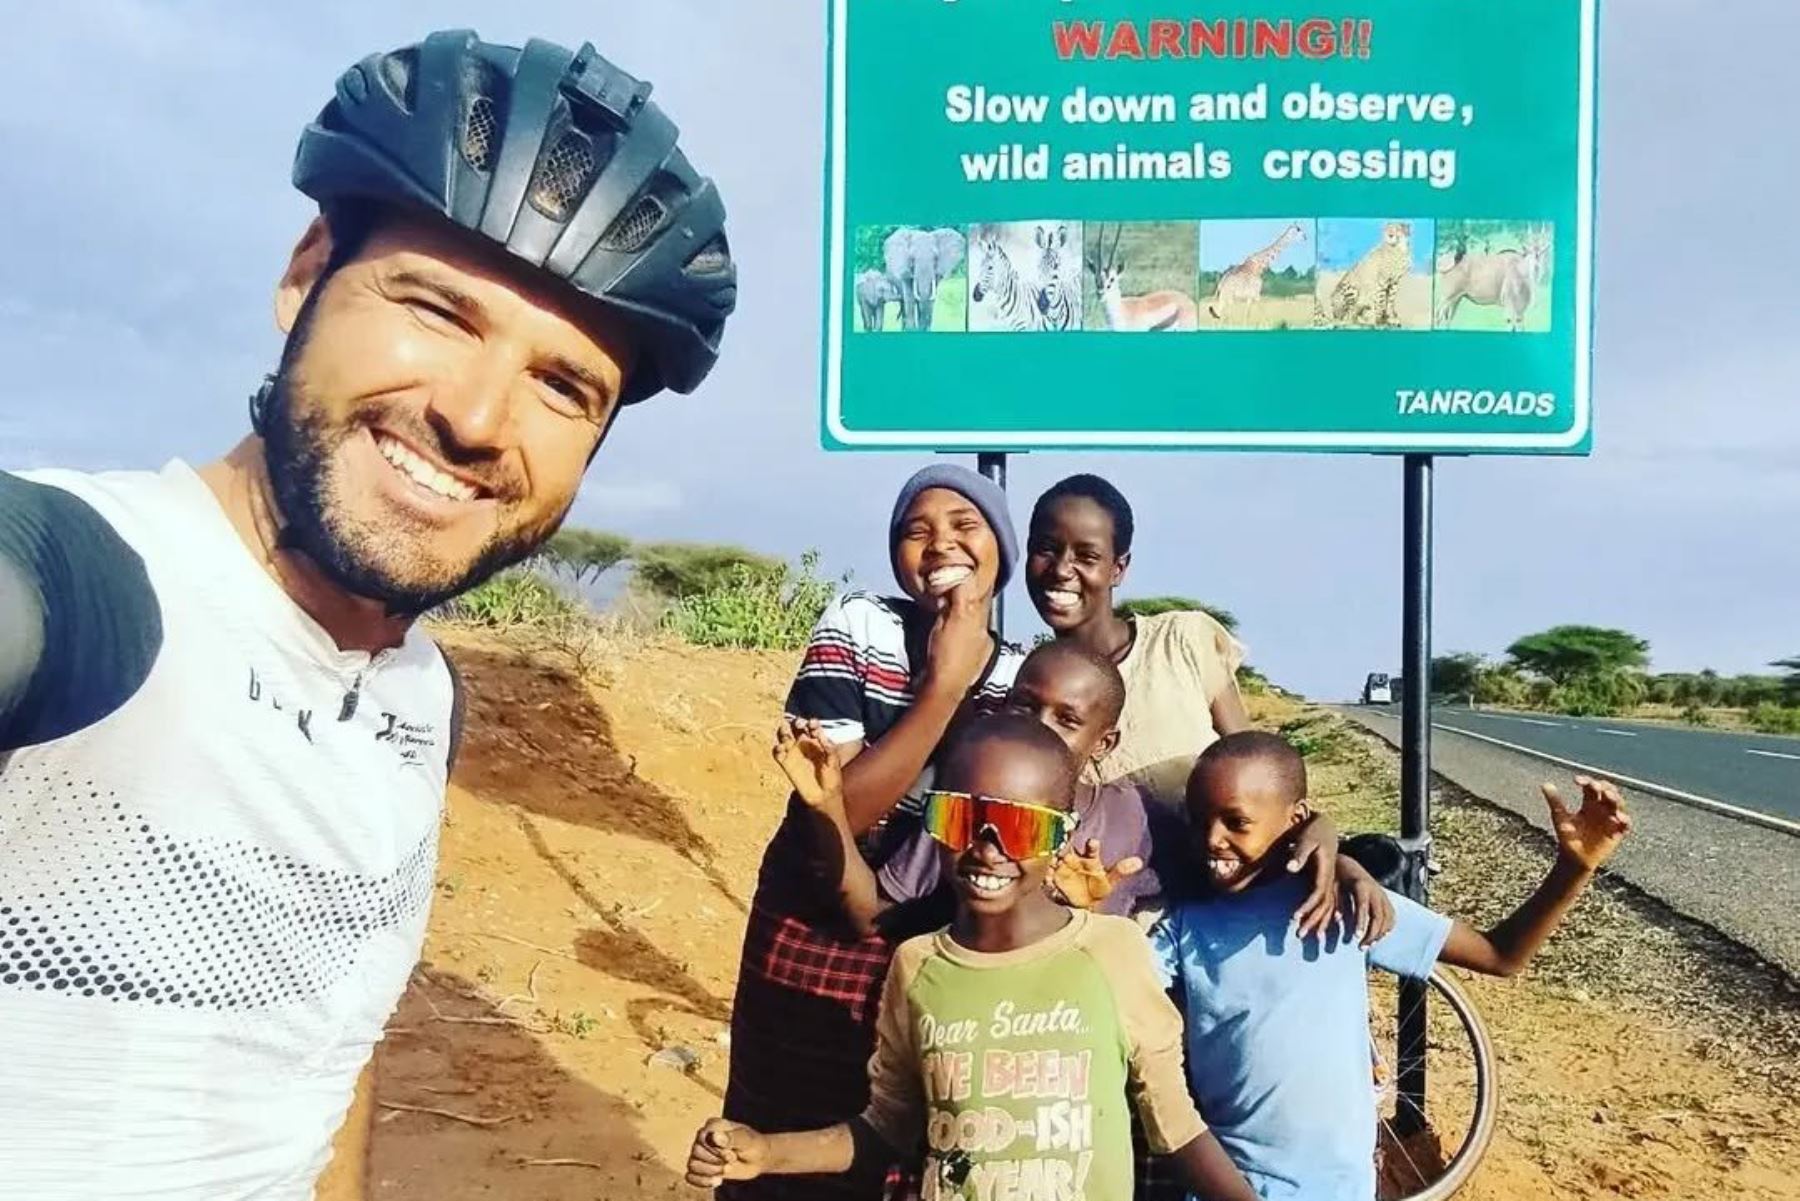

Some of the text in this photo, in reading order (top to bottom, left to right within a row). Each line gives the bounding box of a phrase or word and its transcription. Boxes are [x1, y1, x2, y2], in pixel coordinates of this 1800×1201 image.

[1053, 19, 1372, 59] WARNING!!
[946, 84, 1472, 125] Slow down and observe,
[962, 141, 1455, 188] wild animals crossing
[1397, 391, 1554, 416] TANROADS
[919, 1013, 979, 1050] Dear
[982, 1048, 1093, 1100] BEEN
